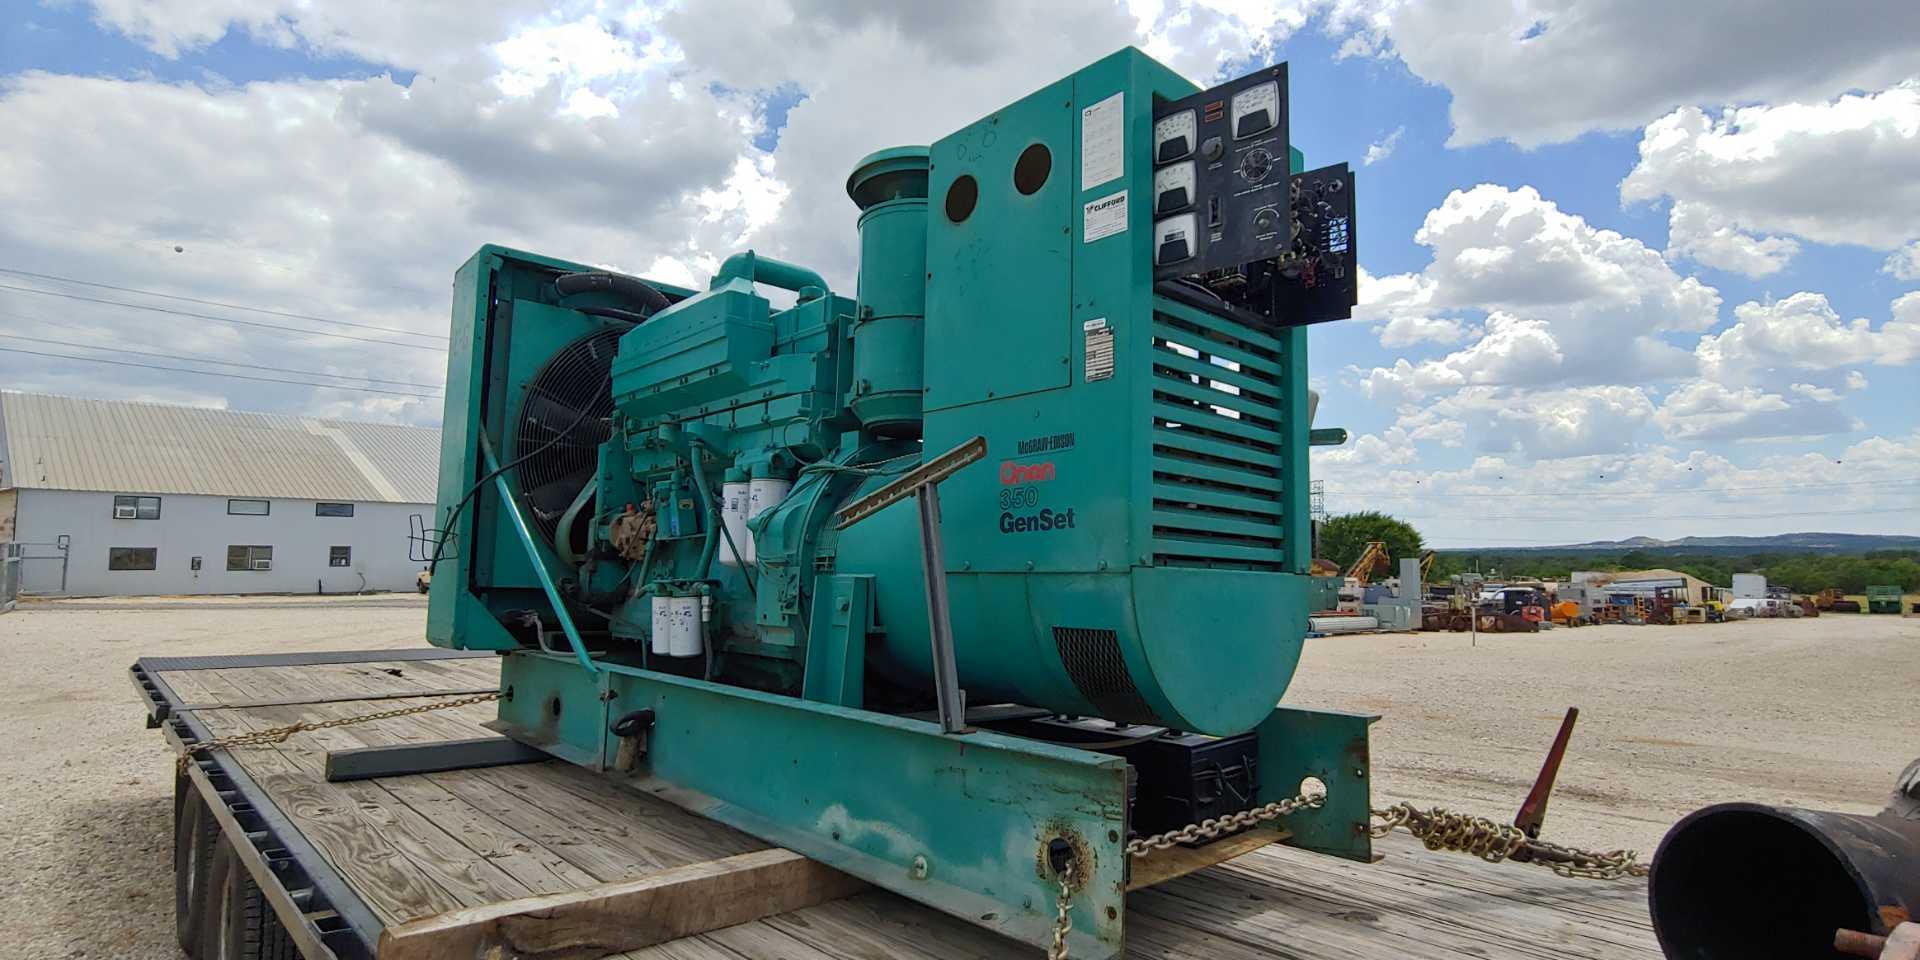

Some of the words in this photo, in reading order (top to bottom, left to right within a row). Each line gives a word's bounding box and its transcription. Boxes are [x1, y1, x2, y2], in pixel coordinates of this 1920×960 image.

[1094, 196, 1125, 212] CLIFFORD
[1001, 461, 1055, 484] Onan
[1001, 486, 1039, 510] 350
[1001, 508, 1076, 534] GenSet
